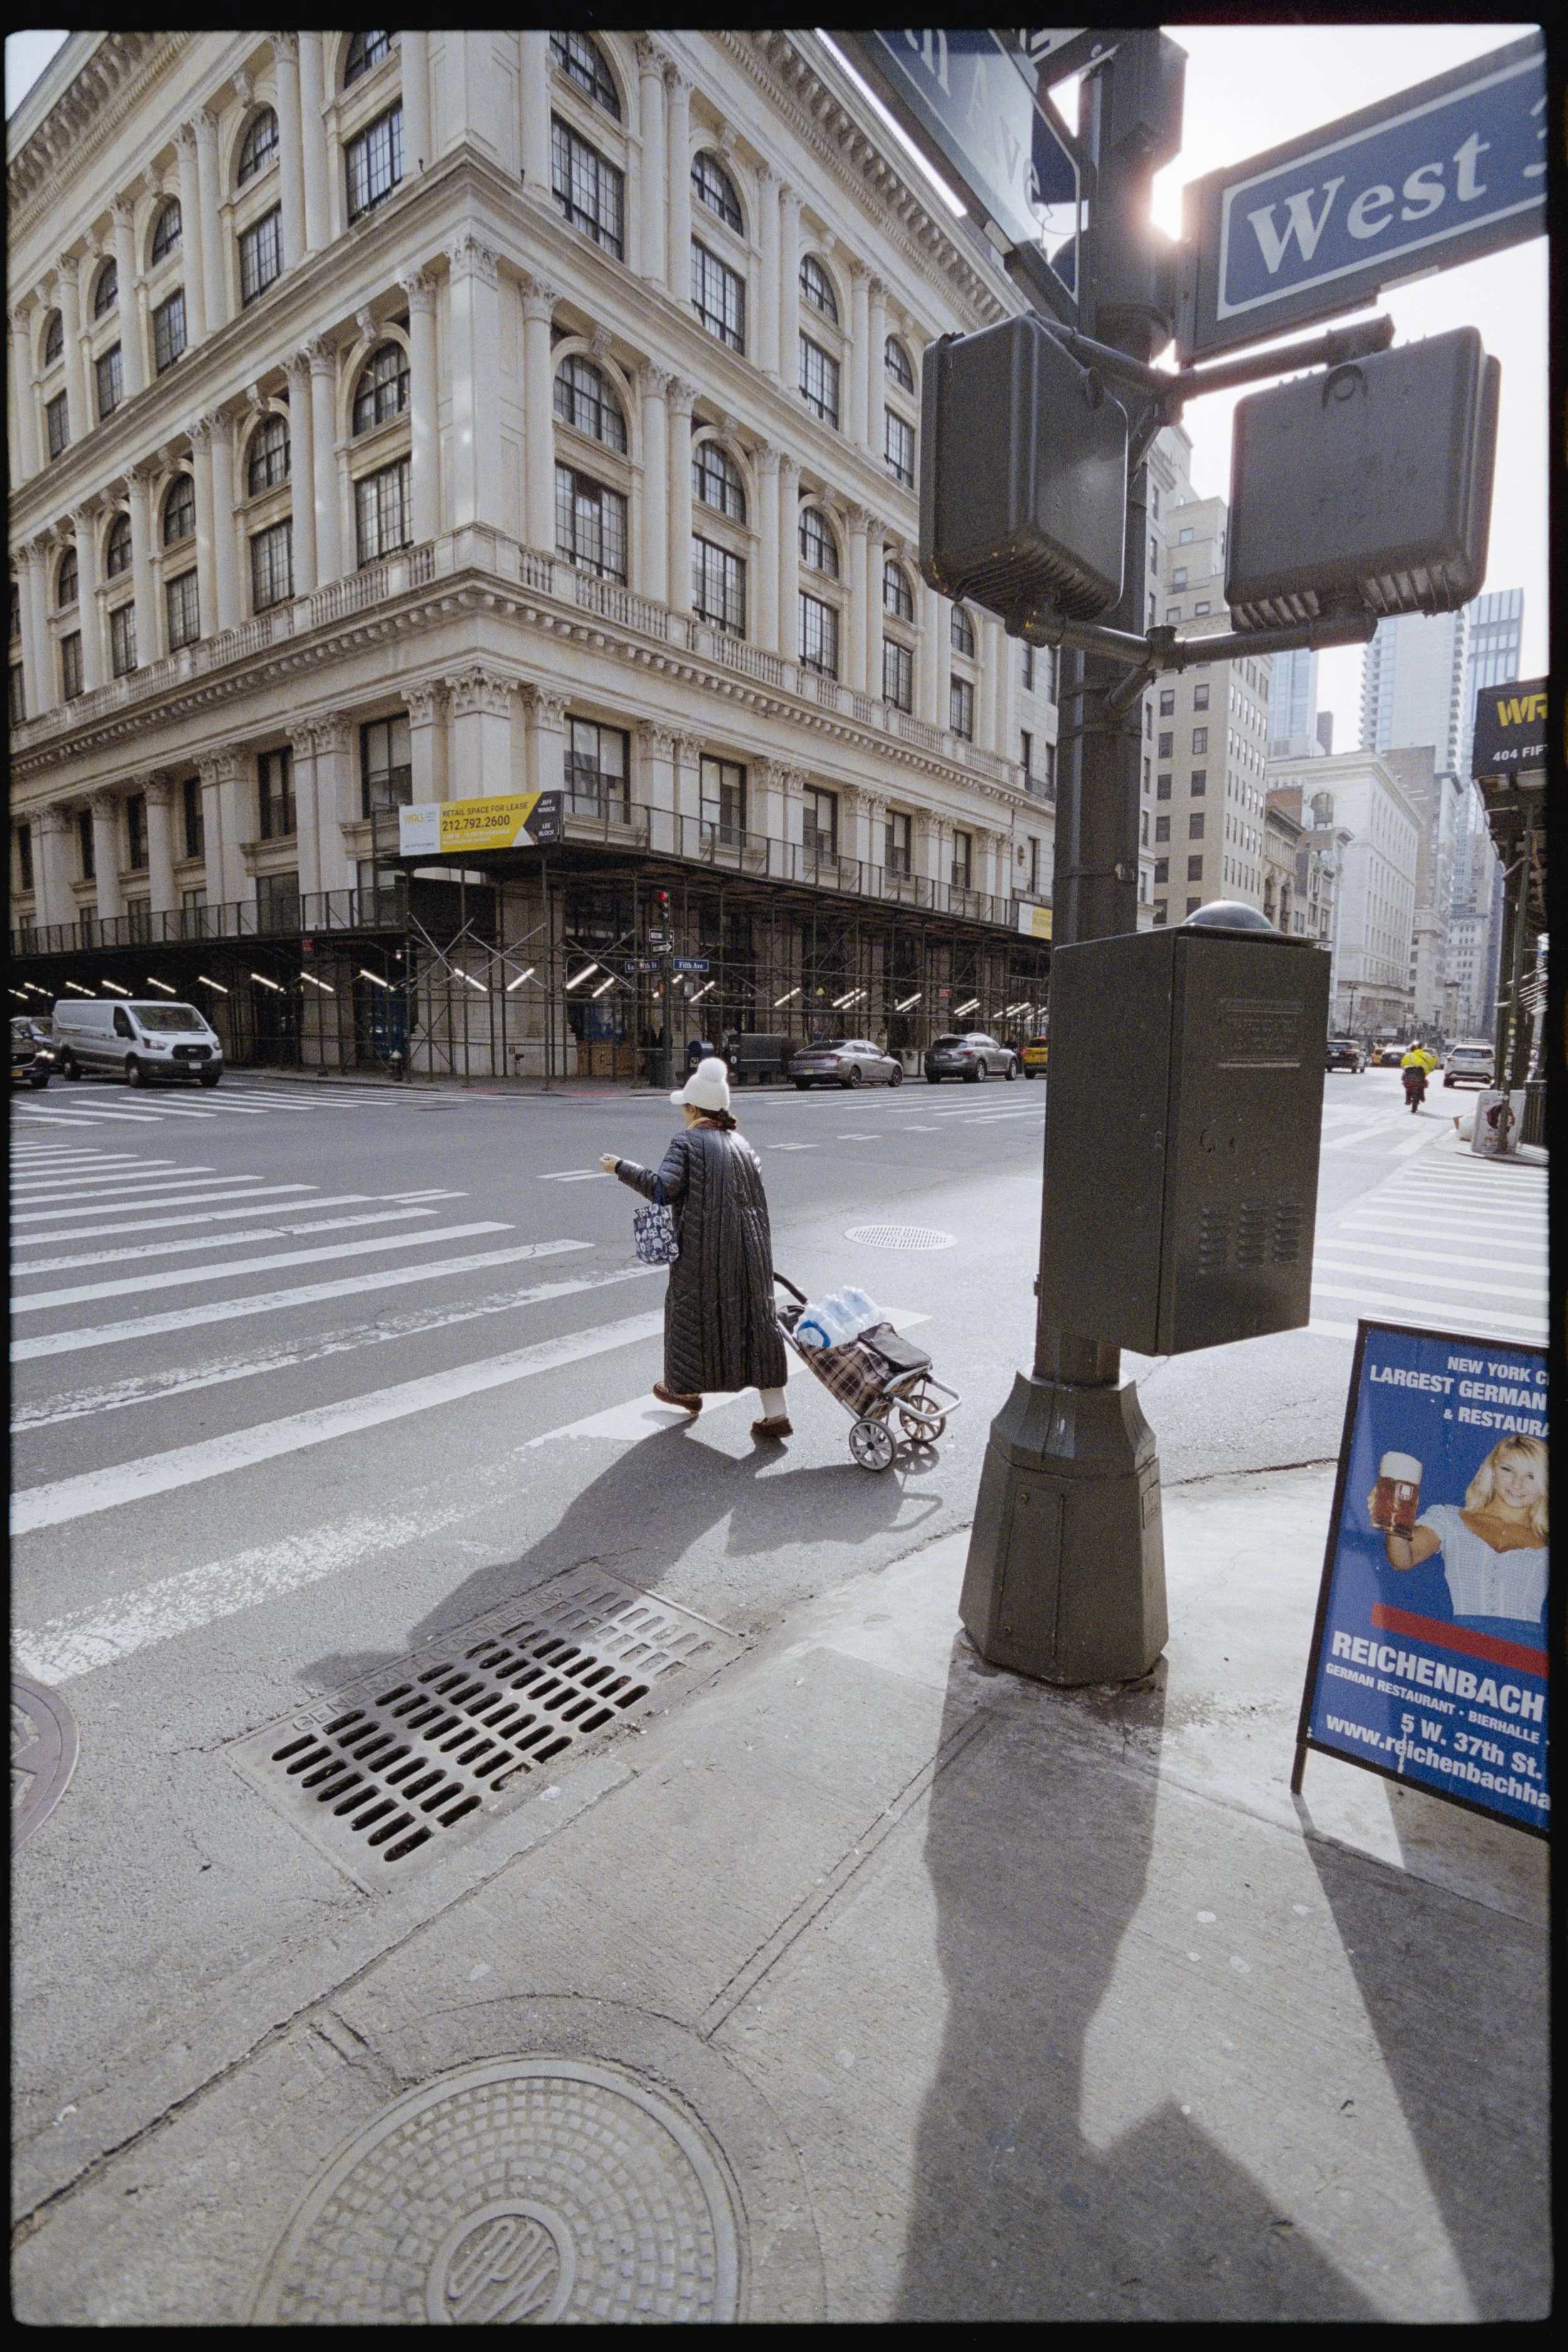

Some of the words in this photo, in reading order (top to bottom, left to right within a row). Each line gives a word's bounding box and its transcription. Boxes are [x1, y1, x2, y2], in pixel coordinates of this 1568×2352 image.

[1247, 132, 1490, 274] West
[1493, 749, 1518, 761] 404
[1522, 744, 1548, 757] FIF
[442, 815, 510, 831] 212.792.2600
[443, 809, 465, 817] RETAIL
[467, 807, 489, 815] SPACE
[507, 802, 528, 811] LEASE
[1370, 1365, 1454, 1394] LARGEST
[1459, 1380, 1547, 1411] GERMAN
[1447, 1356, 1483, 1374] NEW
[1487, 1363, 1531, 1383] YORK
[1443, 1409, 1453, 1420] &
[1331, 1631, 1545, 1722] REICHENBACH
[1326, 1663, 1375, 1688] GERMAN
[1377, 1680, 1456, 1716] RESTAURANT
[1468, 1710, 1540, 1745] BIERHALLE
[1326, 1714, 1550, 1810] www.reichenbachha
[1401, 1713, 1414, 1733] 5
[1421, 1719, 1447, 1745] W.
[1454, 1732, 1505, 1766] 37th
[1511, 1751, 1542, 1780] St.
